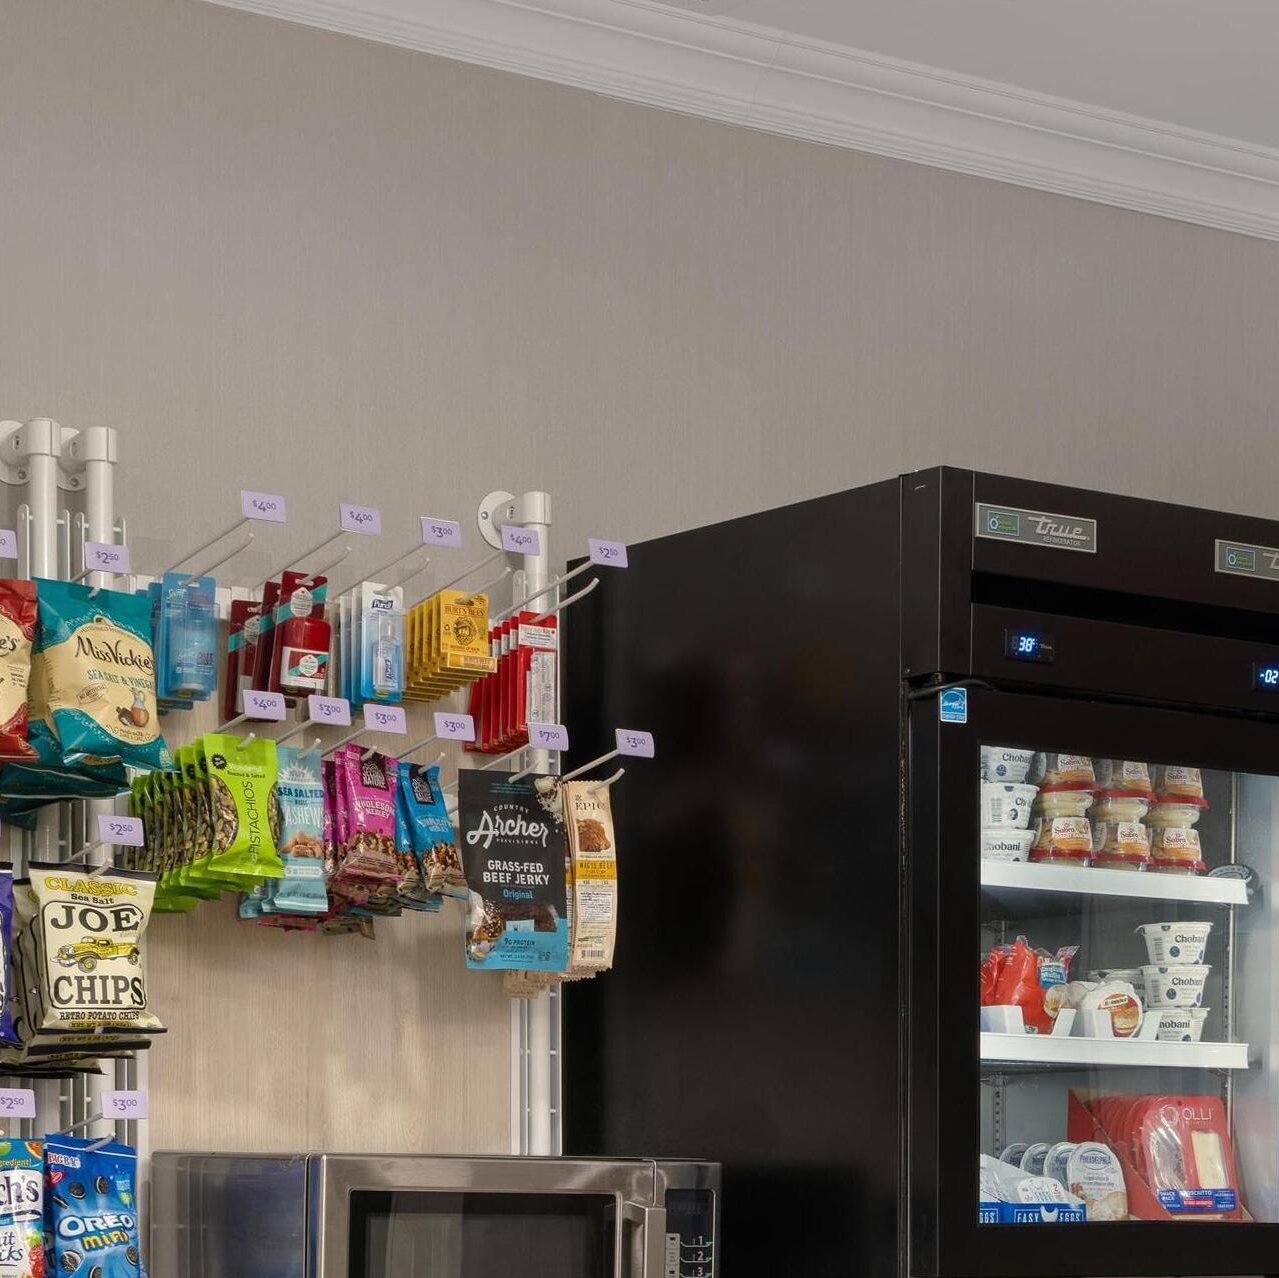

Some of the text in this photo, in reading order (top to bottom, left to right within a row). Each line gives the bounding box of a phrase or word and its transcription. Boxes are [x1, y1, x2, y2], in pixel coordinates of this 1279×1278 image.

[1043, 536, 1081, 546] REFRIGERATOR
[1260, 669, 1278, 683] -02
[278, 787, 324, 797] SEA SALTED
[494, 804, 530, 813] COUNTRY
[466, 811, 548, 849] Archer
[488, 860, 544, 873] GRASS-FED
[483, 872, 550, 885] BEEF JERKY
[44, 877, 138, 897] CLASSIC
[71, 893, 115, 905] Sea Salt
[503, 889, 534, 900] Original
[50, 905, 140, 932] JOE
[53, 975, 144, 1007] CHIPS
[60, 1011, 140, 1021] RETRO POTATO CHIPS
[1182, 1107, 1212, 1121] OLLI
[1017, 1209, 1040, 1222] EASY
[1060, 1209, 1082, 1222] EGGS
[58, 1214, 134, 1237] OREO
[82, 1231, 129, 1250] mini
